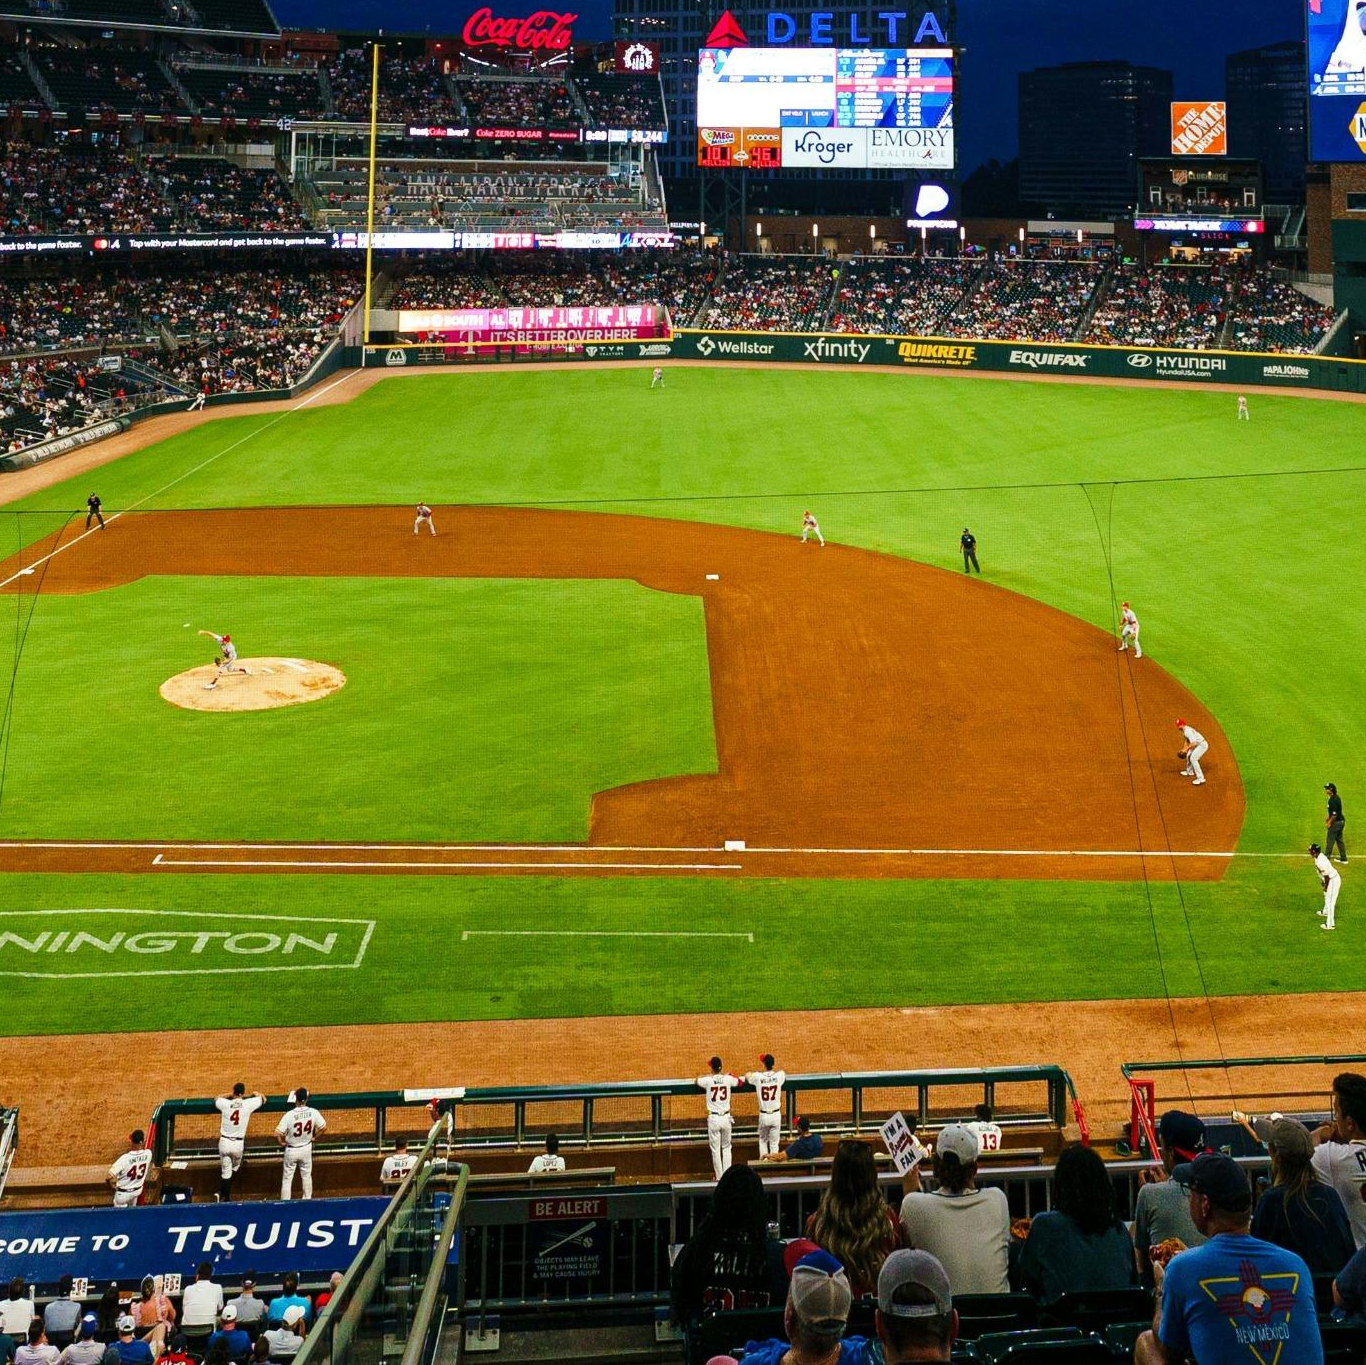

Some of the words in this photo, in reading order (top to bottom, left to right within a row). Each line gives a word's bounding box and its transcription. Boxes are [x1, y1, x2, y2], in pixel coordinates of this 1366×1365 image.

[462, 7, 578, 50] Coca-Cola
[767, 12, 946, 44] DELTA
[1178, 107, 1200, 129] THE
[495, 129, 514, 139] ZERO
[516, 129, 542, 139] SUGAR
[1172, 102, 1225, 154] HOME
[871, 129, 949, 147] EMORY
[1193, 122, 1225, 153] DEPOT
[705, 147, 731, 160] 101
[751, 148, 780, 160] 461
[795, 131, 853, 163] Kroger
[491, 331, 515, 342] IT'S
[517, 330, 565, 342] BETTER
[567, 329, 603, 341] OVER
[605, 328, 638, 340] HERE
[718, 340, 774, 355] Wellstar
[804, 337, 871, 362] xfinity
[898, 341, 976, 360] QUIKRETE
[1009, 350, 1088, 368] EQUIFAX
[1156, 356, 1227, 371] HYUNDAI
[1156, 368, 1212, 378] HyundaiUSA.com
[710, 1085, 728, 1102] 73
[761, 1084, 778, 1102] 67
[230, 1110, 241, 1125] 4
[293, 1120, 313, 1137] 34
[981, 1133, 997, 1151] 13
[900, 1152, 918, 1170] FAN
[126, 1162, 147, 1183] 43
[535, 1202, 554, 1216] BE
[557, 1200, 600, 1215] ALERT
[92, 1234, 131, 1252] TO
[168, 1218, 374, 1254] TRUIST
[534, 1256, 563, 1264] OBJECTS
[579, 1254, 599, 1262] LEAVE
[550, 1263, 578, 1271] PLAYING
[579, 1262, 598, 1270] FIELD
[1235, 1326, 1257, 1345] NEW
[1257, 1323, 1291, 1342] MEXICO
